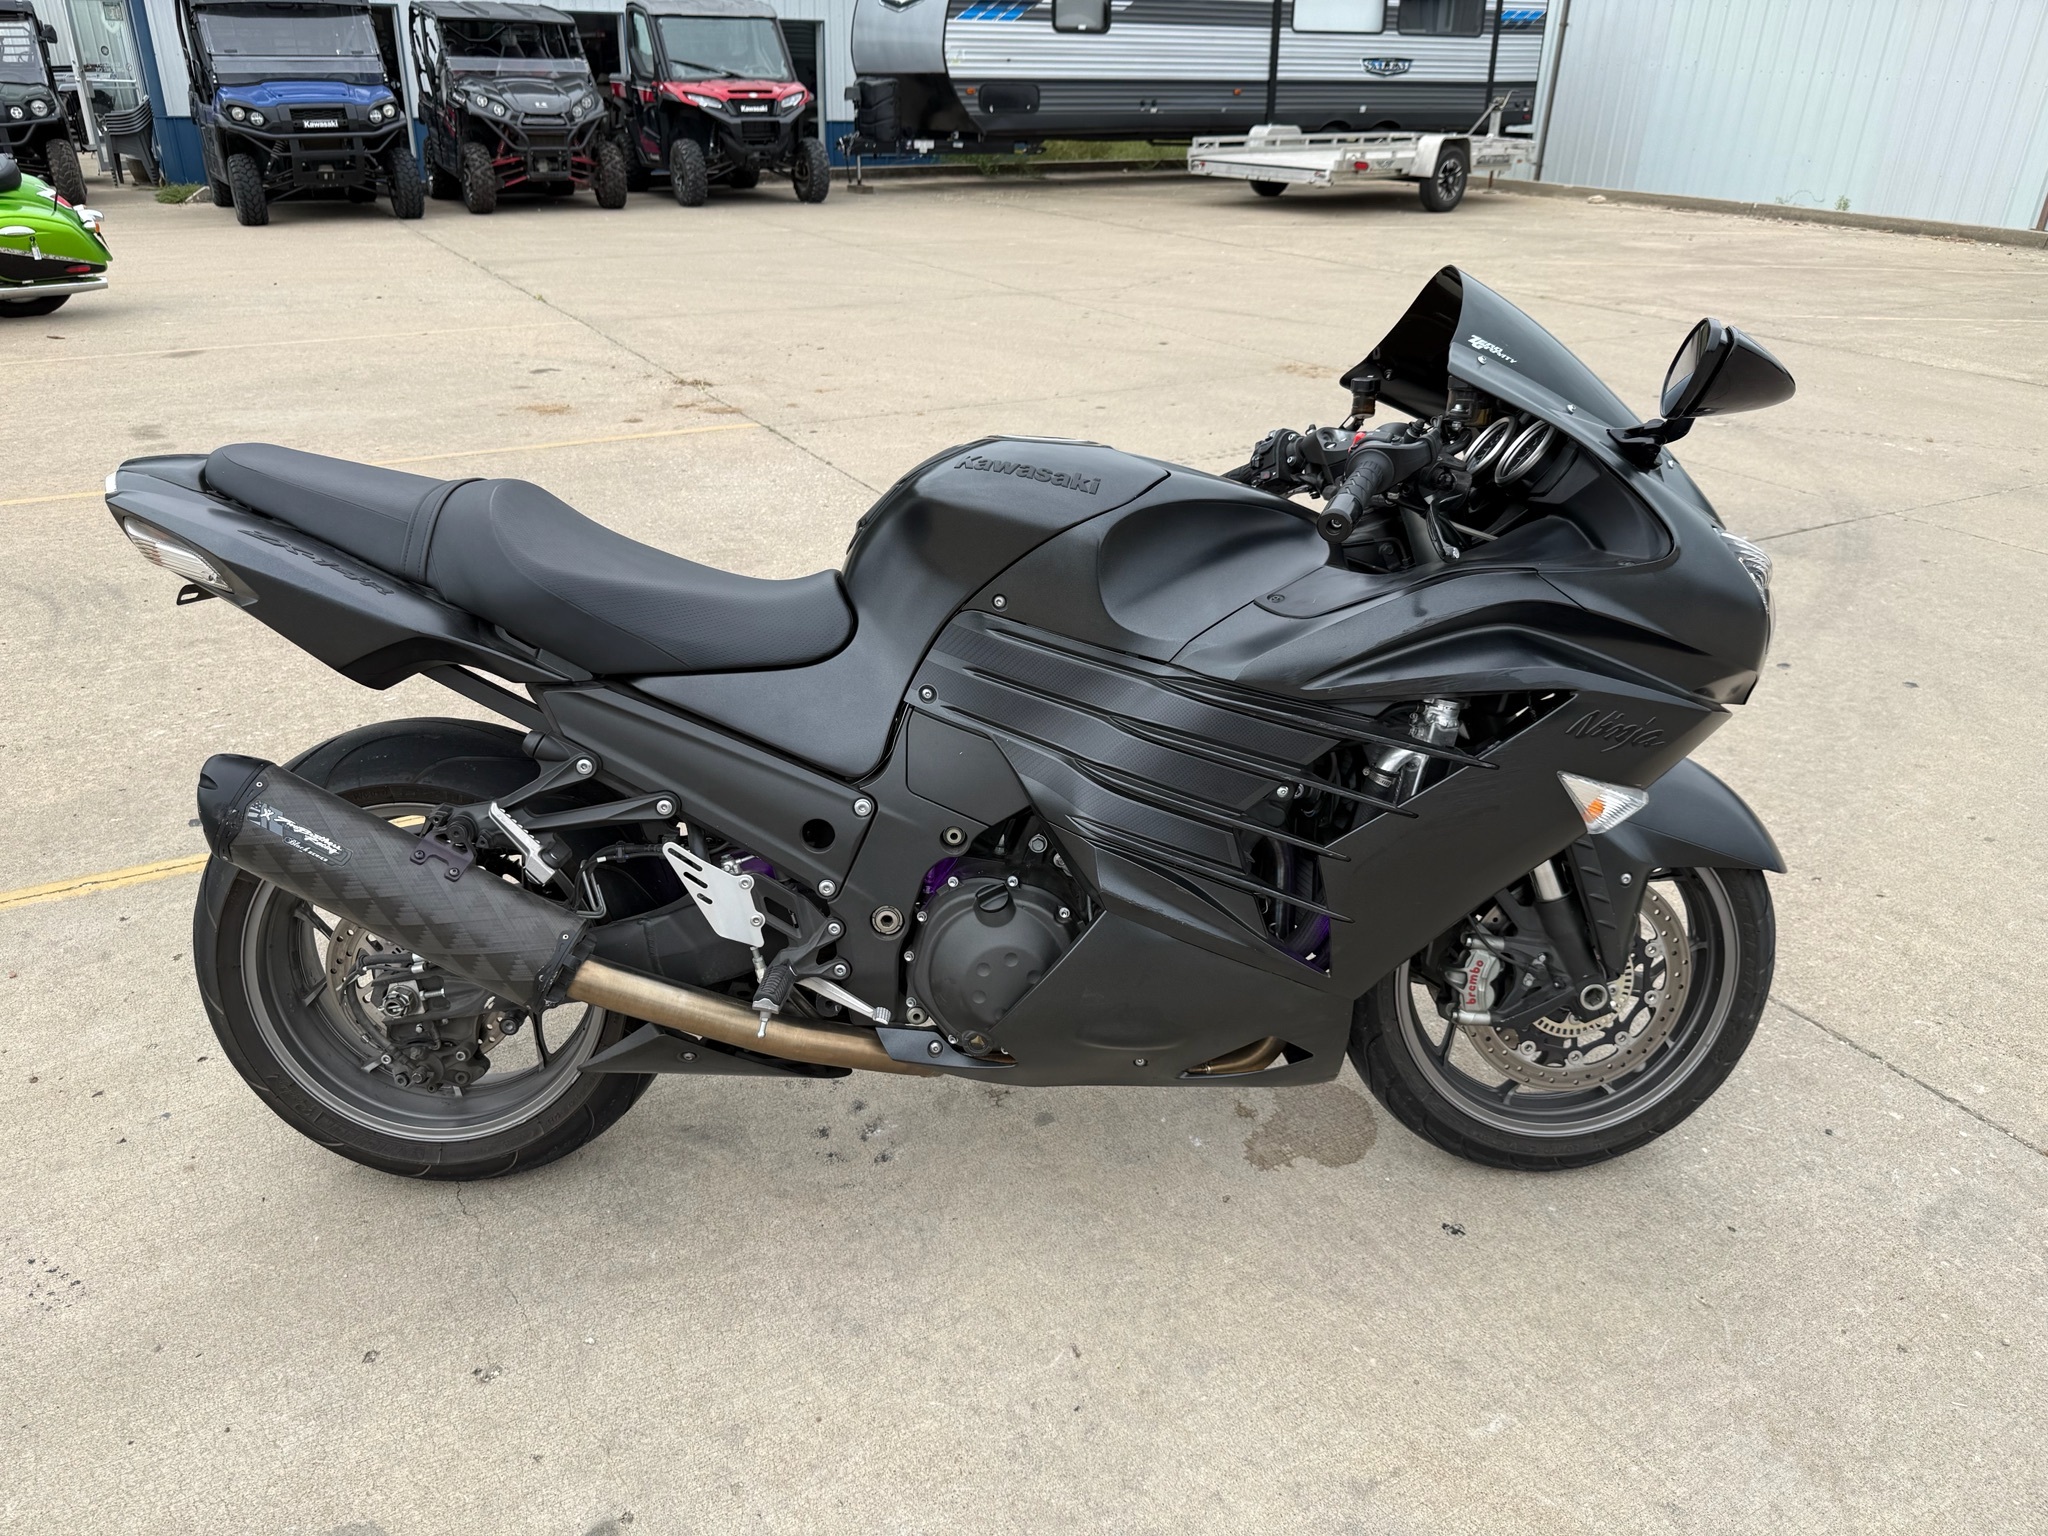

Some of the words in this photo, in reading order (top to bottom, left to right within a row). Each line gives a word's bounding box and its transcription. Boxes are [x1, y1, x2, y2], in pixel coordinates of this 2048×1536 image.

[303, 119, 339, 128] Kawasaki
[740, 104, 768, 113] Kawasaki
[953, 455, 1102, 496] Kawasaki
[1565, 709, 1666, 752] Ninja
[1466, 960, 1484, 1005] brembo
